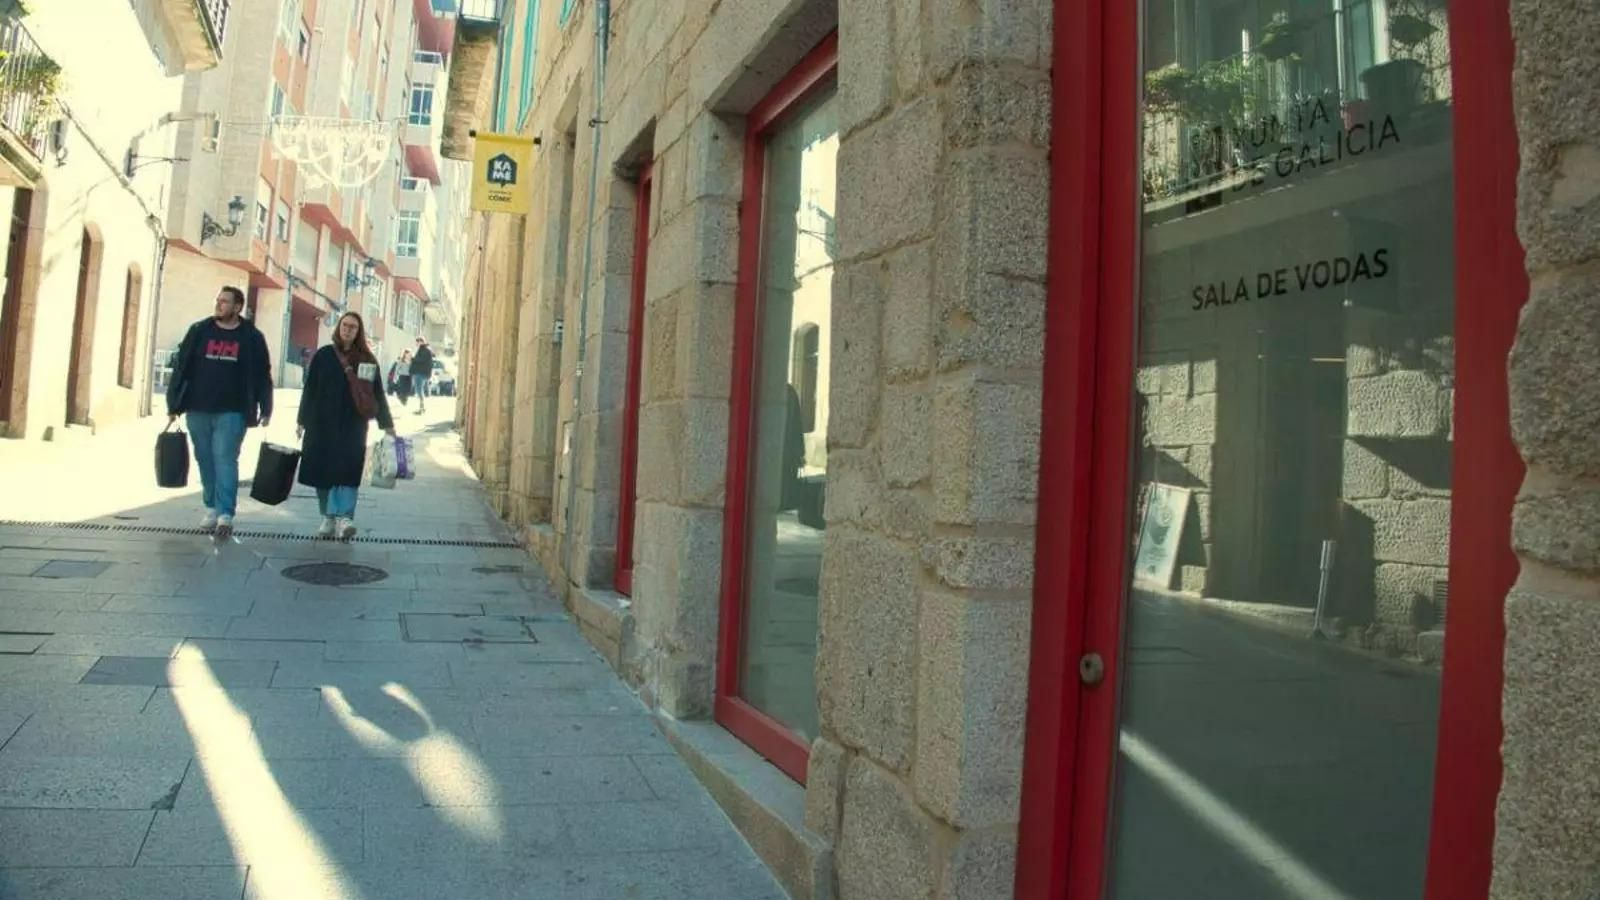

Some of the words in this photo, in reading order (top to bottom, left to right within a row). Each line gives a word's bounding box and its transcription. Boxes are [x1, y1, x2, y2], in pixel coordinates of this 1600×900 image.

[494, 160, 512, 171] KA
[1275, 115, 1400, 177] GALICIA
[1192, 275, 1249, 310] SALA
[1257, 268, 1287, 298] DE
[1295, 248, 1388, 291] VODAS
